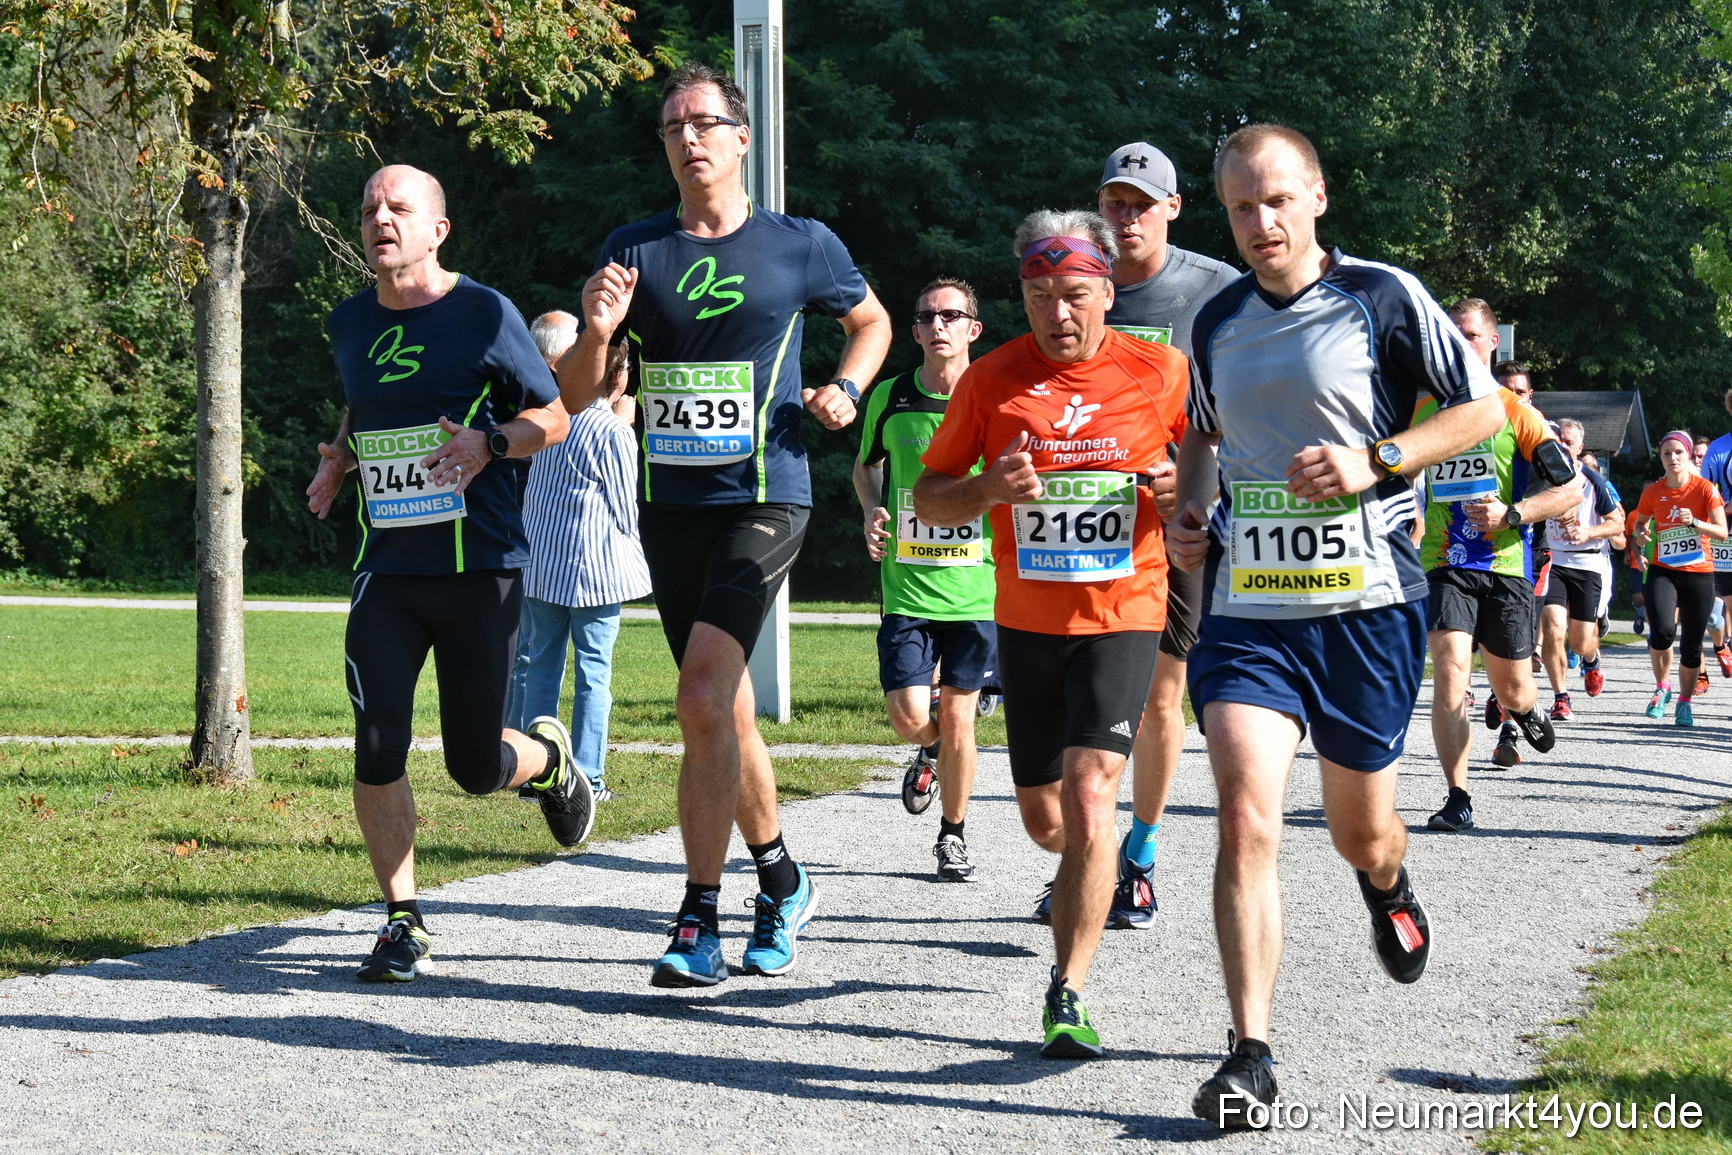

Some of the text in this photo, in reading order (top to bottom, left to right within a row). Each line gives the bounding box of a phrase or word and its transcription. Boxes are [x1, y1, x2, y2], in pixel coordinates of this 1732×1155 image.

[645, 366, 744, 390] BOCK
[653, 399, 740, 430] 2439
[361, 427, 441, 458] BOCK
[655, 438, 741, 453] BERTHOLD
[1027, 436, 1118, 452] funrunners
[1052, 447, 1130, 464] neumarkt
[369, 458, 441, 495] 244
[1433, 457, 1488, 480] 2729
[1040, 476, 1127, 502] OCK
[374, 496, 454, 517] JOHANNES
[1027, 511, 1121, 543] 2160
[1661, 528, 1697, 540] BOCK
[909, 545, 968, 557] TORSTEN
[1244, 524, 1346, 562] 1105
[1663, 539, 1697, 555] 2799
[1031, 553, 1117, 569] HARTMUT
[1243, 572, 1351, 590] JOHANNES
[1110, 726, 1132, 738] adidas
[760, 851, 785, 867] umbro
